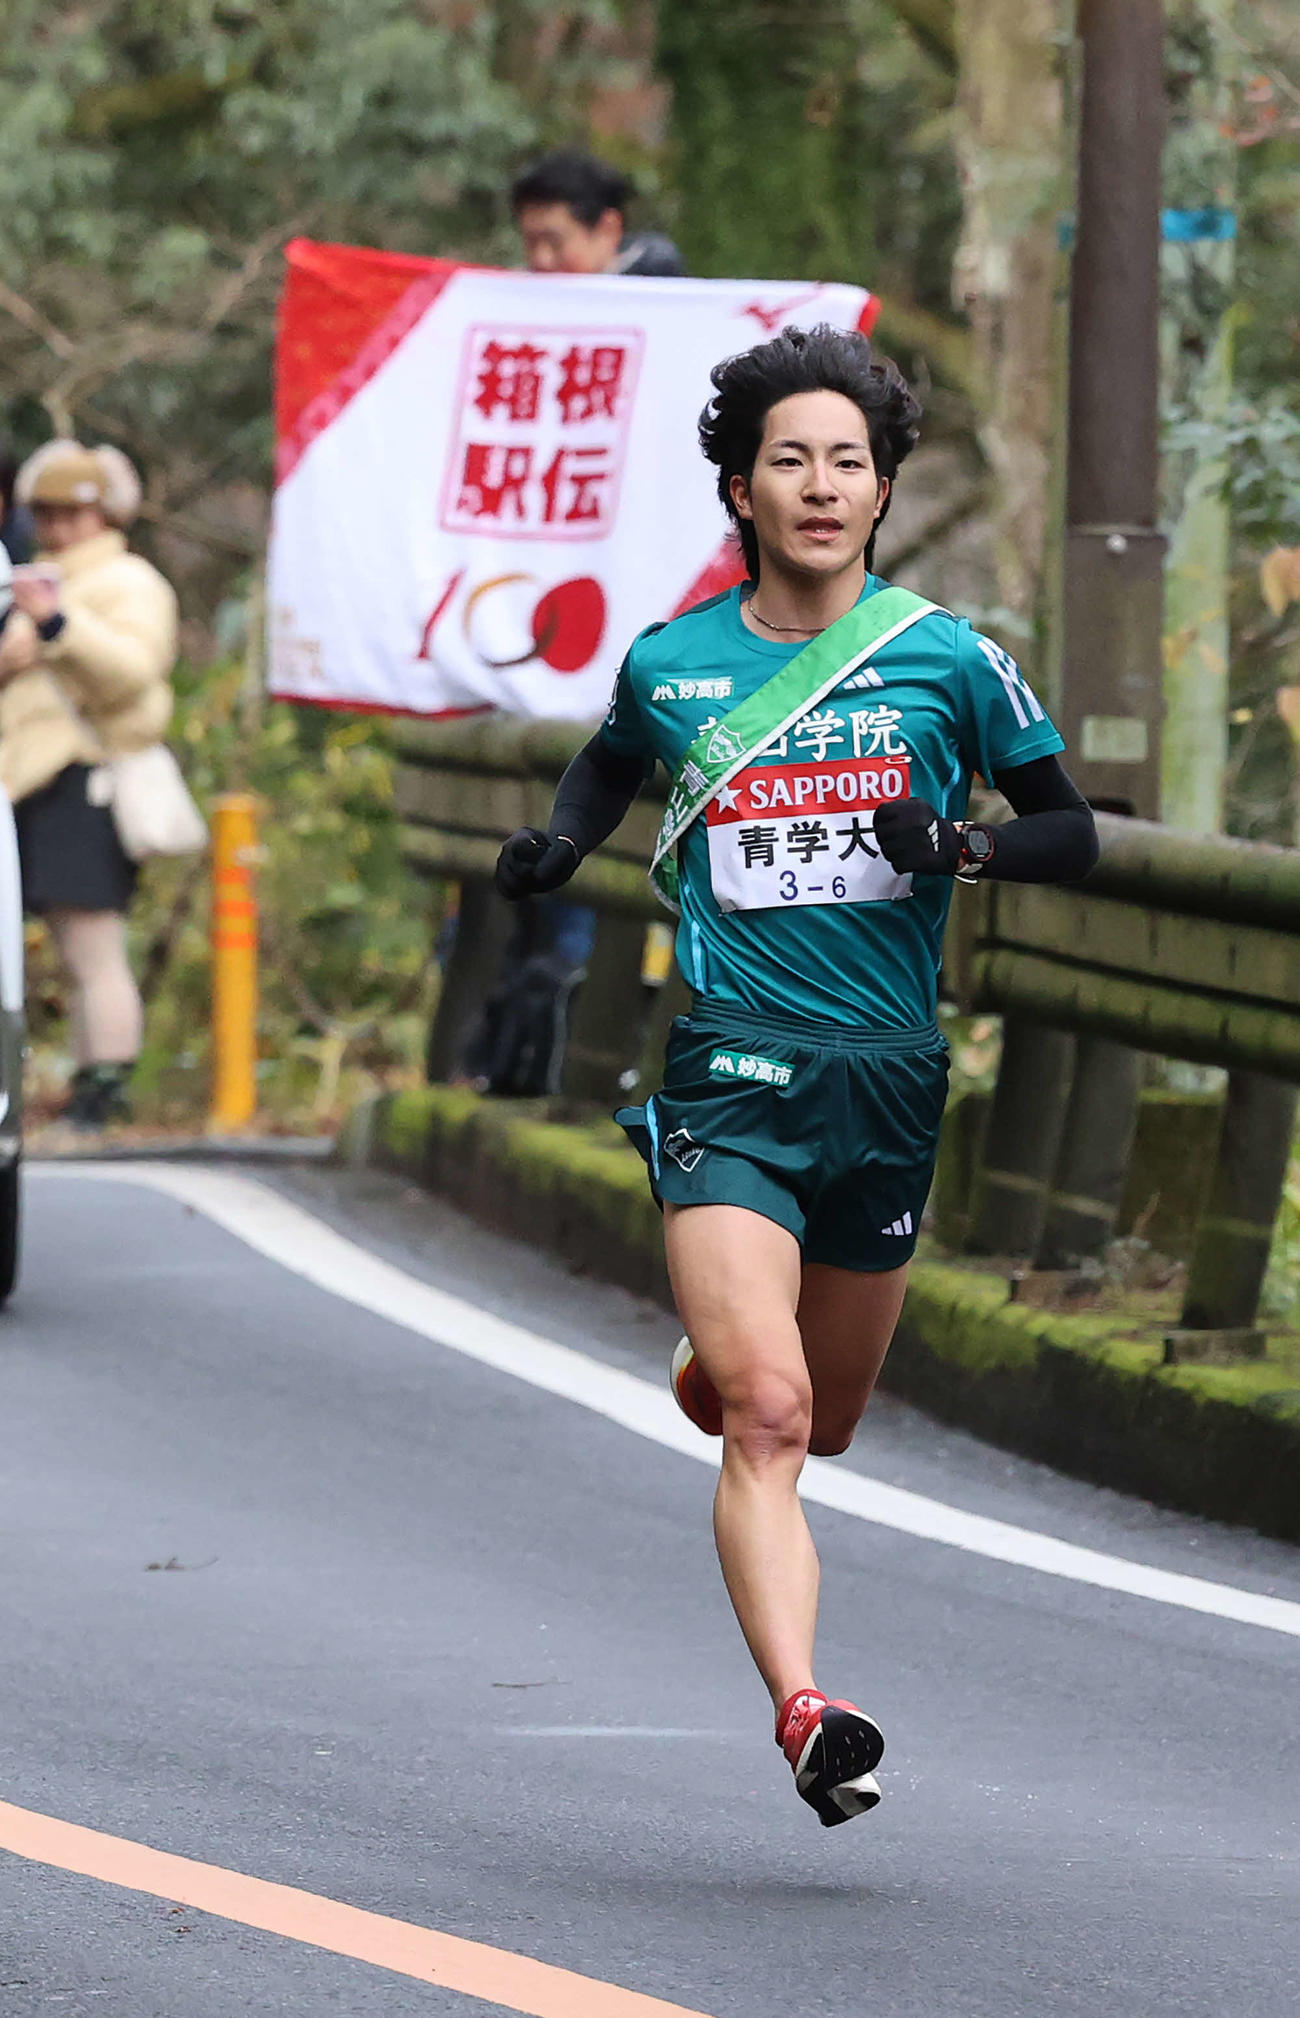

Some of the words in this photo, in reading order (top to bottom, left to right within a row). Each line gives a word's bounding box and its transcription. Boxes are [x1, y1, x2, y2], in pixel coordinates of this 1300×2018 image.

[474, 340, 626, 425] 箱根
[456, 442, 609, 523] 駅伝
[678, 680, 733, 699] 妙高市
[750, 768, 903, 810] SAPPORO
[737, 817, 879, 869] 青学大
[736, 1056, 793, 1085] 妙高市
